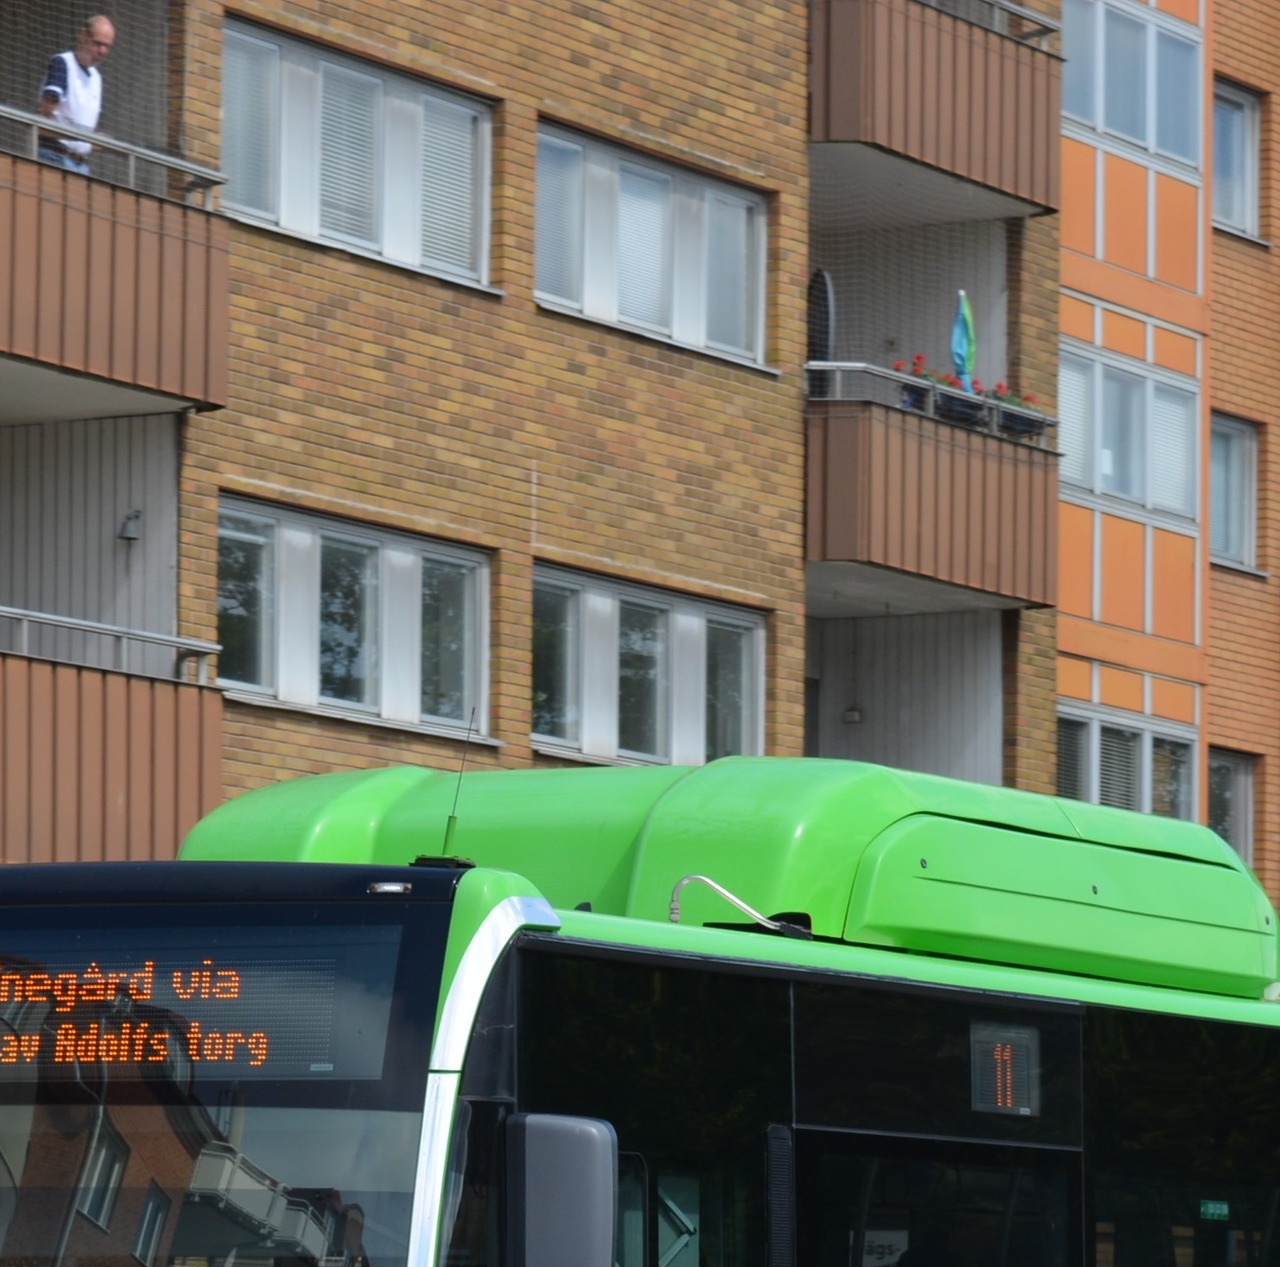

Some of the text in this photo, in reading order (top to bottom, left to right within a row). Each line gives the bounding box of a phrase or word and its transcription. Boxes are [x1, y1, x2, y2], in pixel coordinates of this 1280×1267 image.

[172, 960, 241, 999] via
[54, 1022, 170, 1063] Adolfs
[186, 1022, 268, 1066] torg
[993, 1043, 1014, 1108] 11
